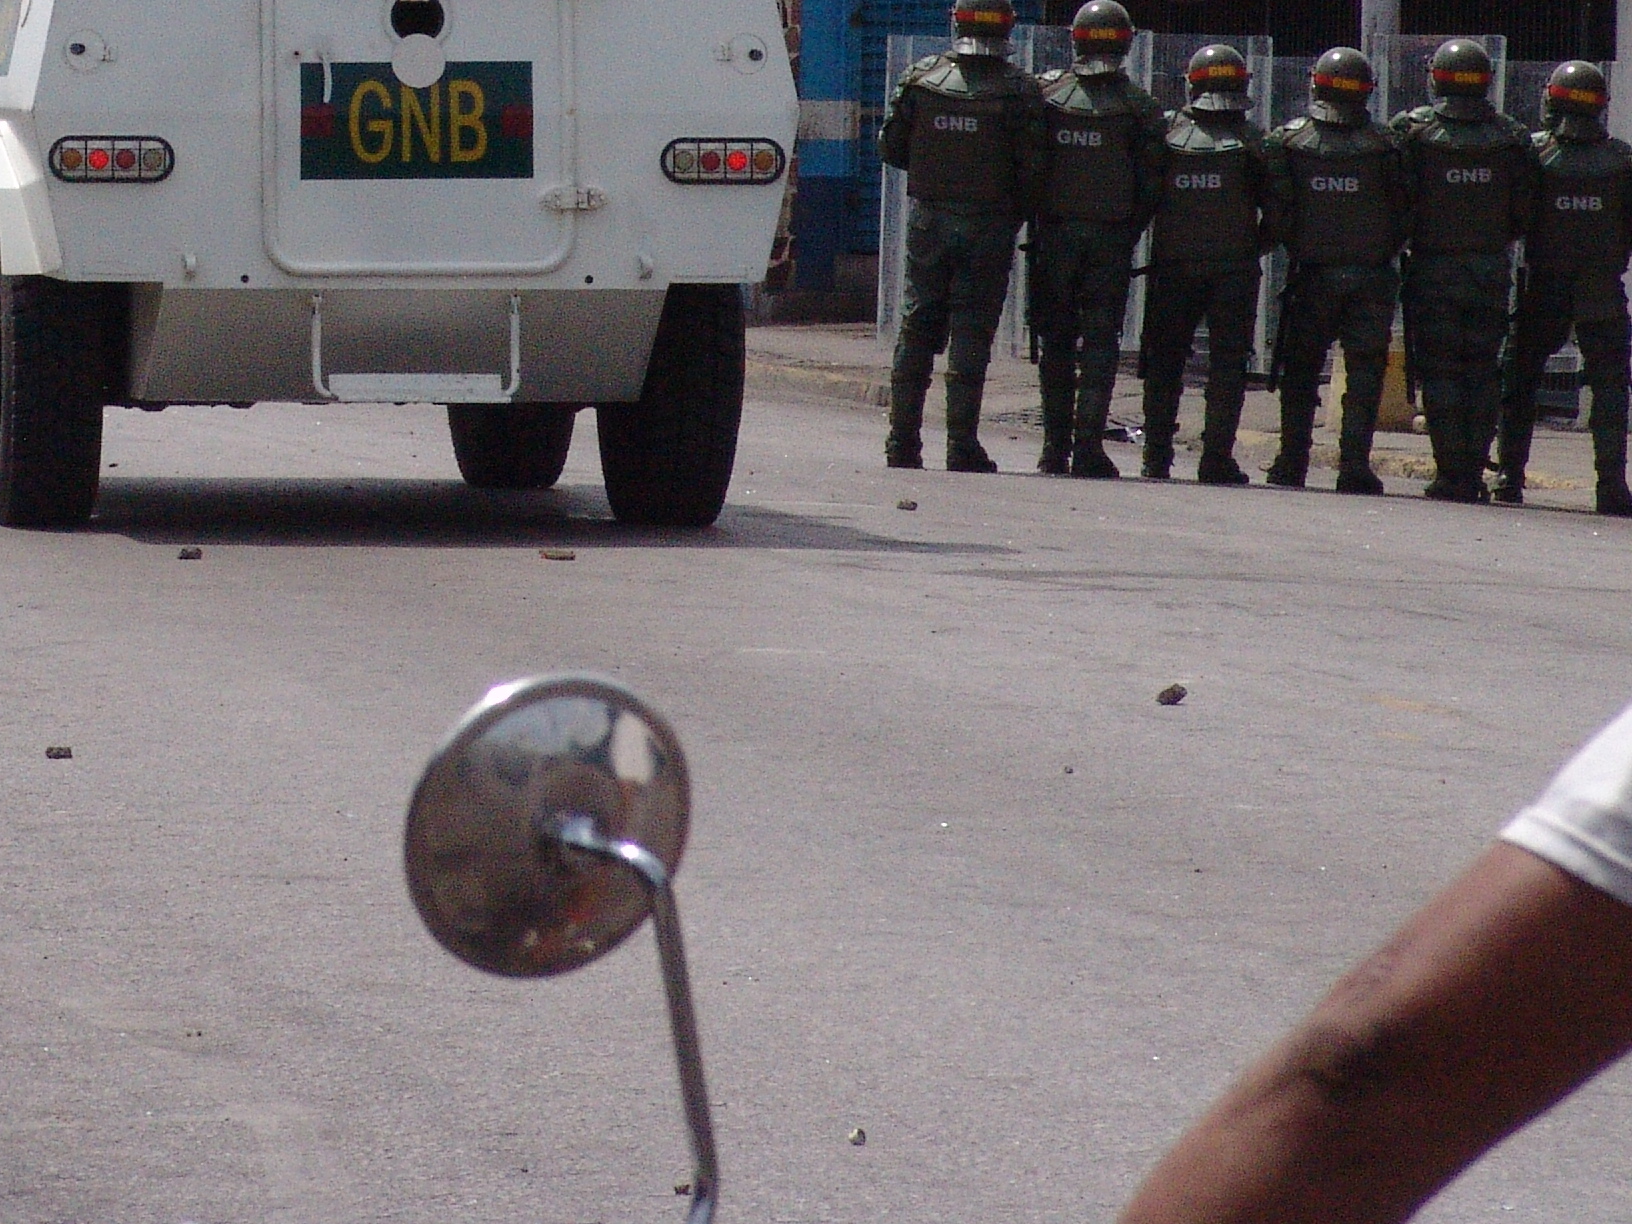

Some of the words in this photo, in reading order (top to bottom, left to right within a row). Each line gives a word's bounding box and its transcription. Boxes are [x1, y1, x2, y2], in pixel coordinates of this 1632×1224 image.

[348, 79, 488, 163] GNB
[934, 116, 977, 132] GNB
[1057, 130, 1102, 146] GNB
[1175, 174, 1221, 189] GNB
[1446, 168, 1492, 183] GNB
[1311, 177, 1358, 192] GNB
[1556, 196, 1603, 212] GNB
